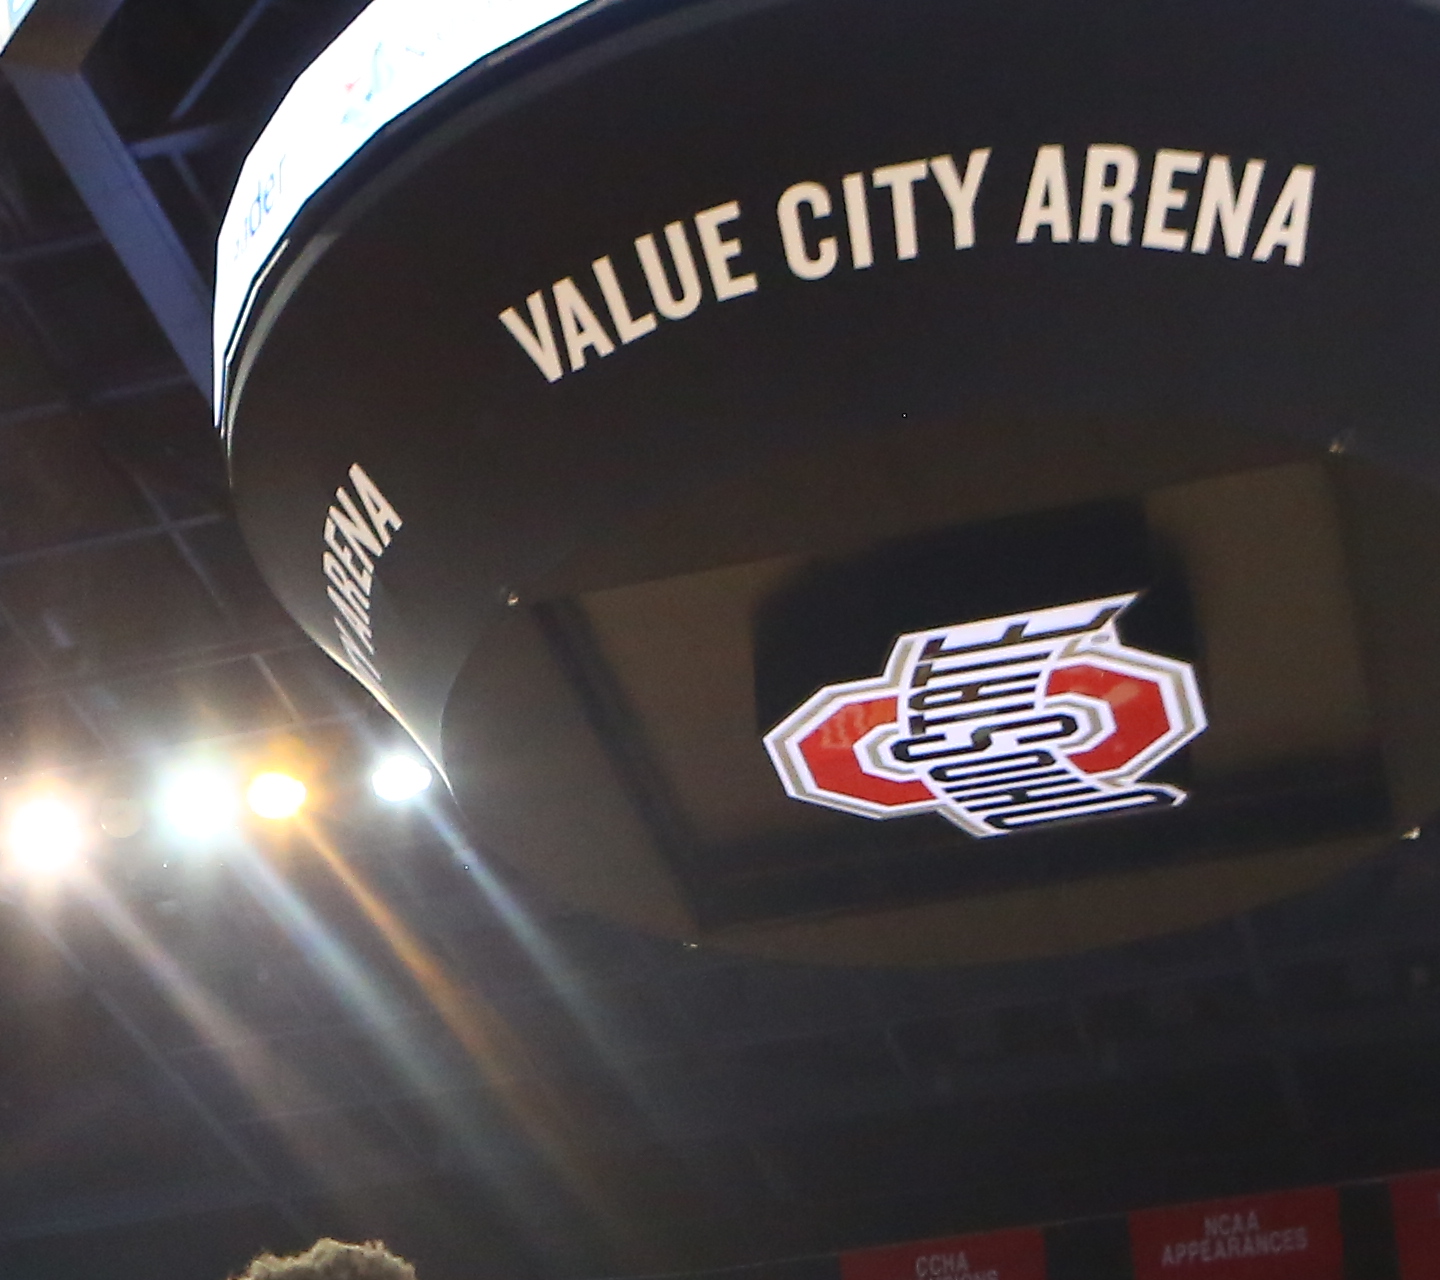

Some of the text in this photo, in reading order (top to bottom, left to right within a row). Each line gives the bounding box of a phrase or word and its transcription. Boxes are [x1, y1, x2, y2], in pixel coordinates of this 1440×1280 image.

[498, 143, 1316, 384] VALUE CITY ARENA
[322, 462, 403, 655] ARENA
[1161, 1226, 1308, 1268] APPEARANCES
[1204, 1210, 1260, 1237] NCAA
